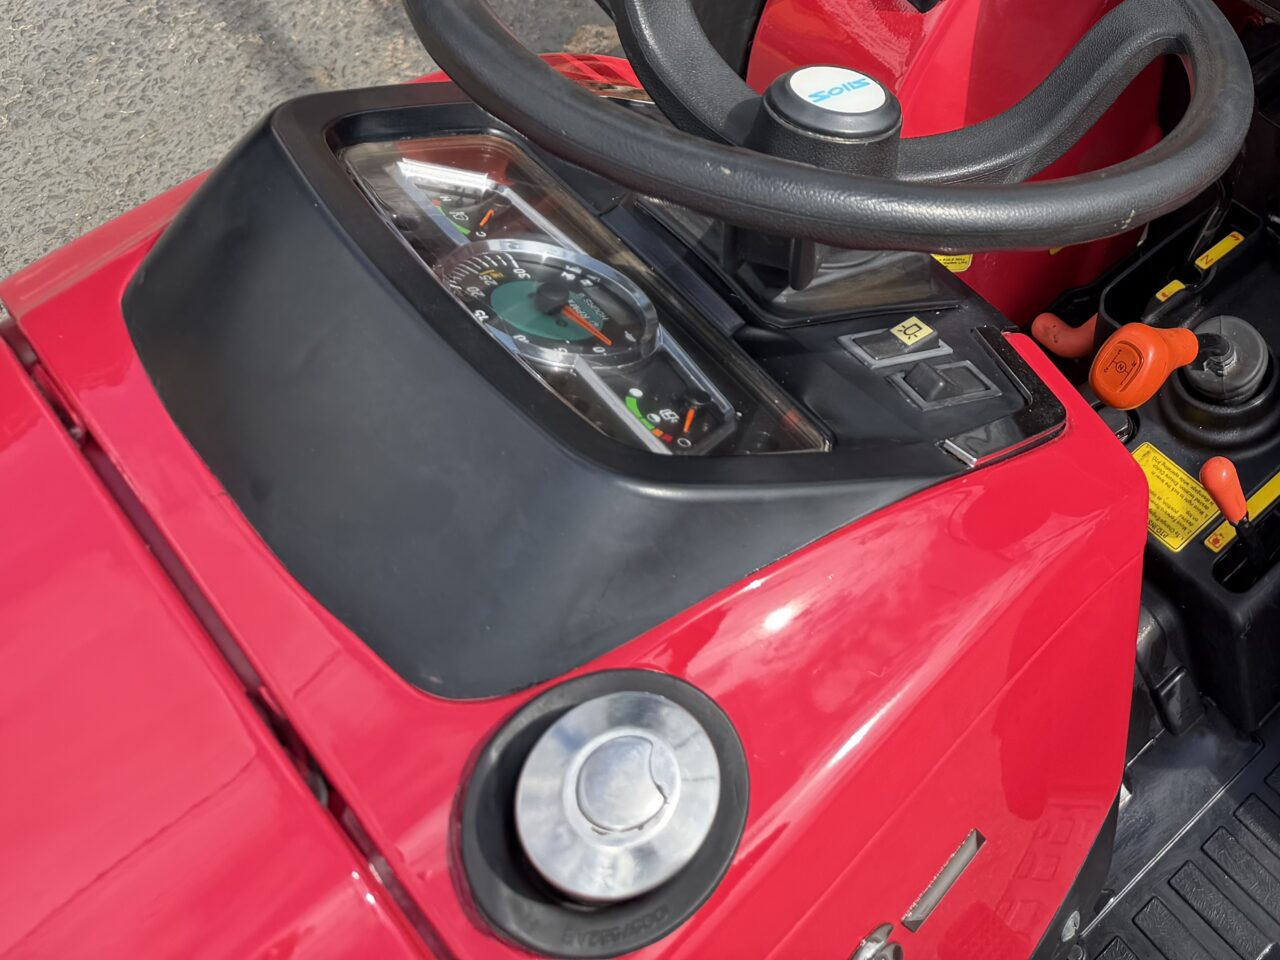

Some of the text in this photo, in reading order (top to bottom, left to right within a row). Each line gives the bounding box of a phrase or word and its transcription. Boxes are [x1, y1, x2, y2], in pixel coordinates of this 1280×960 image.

[513, 268, 531, 279] 30
[466, 286, 485, 298] 20
[475, 310, 489, 321] 15
